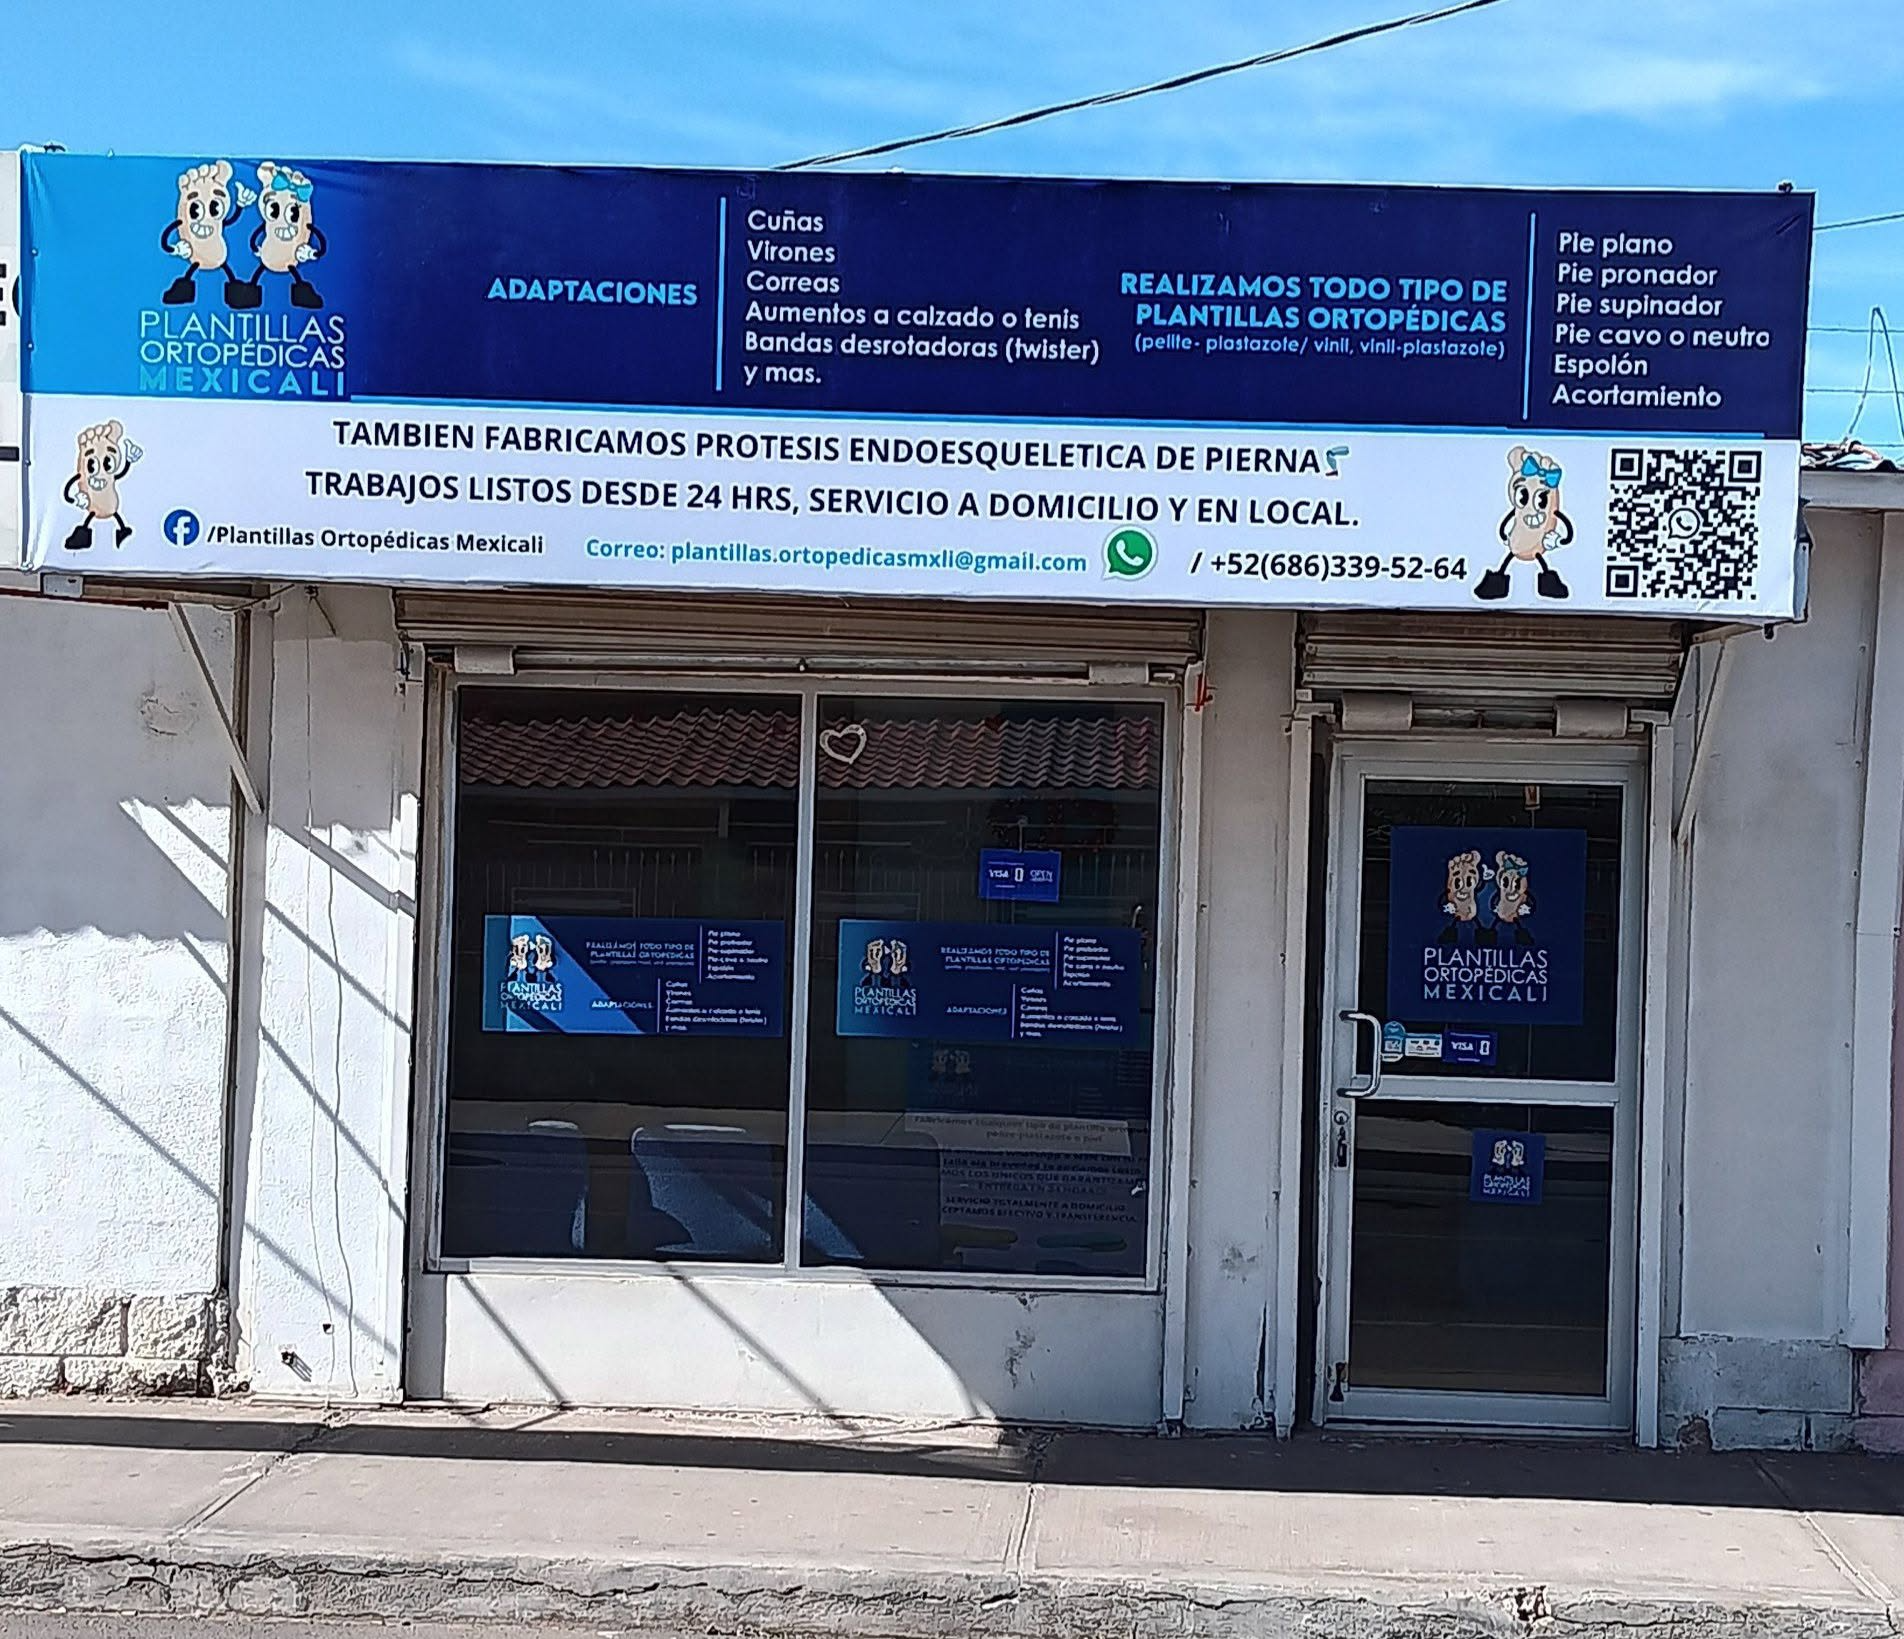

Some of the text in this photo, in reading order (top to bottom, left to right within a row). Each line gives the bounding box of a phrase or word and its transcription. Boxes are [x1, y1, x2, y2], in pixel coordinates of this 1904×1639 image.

[747, 209, 824, 233] Cuñas
[747, 240, 836, 263] Virones
[1558, 232, 1673, 258] Pie plano
[746, 270, 840, 293] Correas
[1121, 272, 1508, 303] REALIZAMOS TODO TIPO DE
[1557, 262, 1718, 288] Pie pronador
[487, 277, 699, 306] ADAPTACIONES
[1556, 292, 1723, 319] Pie supinador
[139, 311, 345, 344] PLANTILLAS
[745, 300, 1080, 330] Aumentos a calzado o tenis
[1136, 303, 1507, 333] PLANTILLAS ORTOPÉDICAS
[745, 331, 1100, 365] Bandas desrotadoras (twister)
[1555, 323, 1770, 347] Pie cavo o neutro
[139, 339, 345, 370] ORTOPÉDICAS
[1554, 352, 1648, 378] Espolón
[138, 367, 345, 397] MEXICALI
[743, 365, 822, 387] y mas.
[1551, 383, 1722, 407] Acortamiento
[333, 420, 1321, 475] TAMBIEN FABRICAMOS PROTESIS ENDOESQUELETICA DE PIERNA
[305, 471, 1359, 527] TRABAJOS LISTOS DESDE 24 HRS, SERVICIO A DOMICILIO Y EN LOCAL.
[207, 525, 544, 556] /Plantillas Ortopédicas Mexicali
[586, 537, 1087, 574] Correo: plantillas.ortopedicasmxli@gmail.com
[1210, 553, 1468, 582] +52(686)339-52-64
[1424, 947, 1548, 969] PLANTILLAS
[1424, 985, 1547, 1002] MEXICALI
